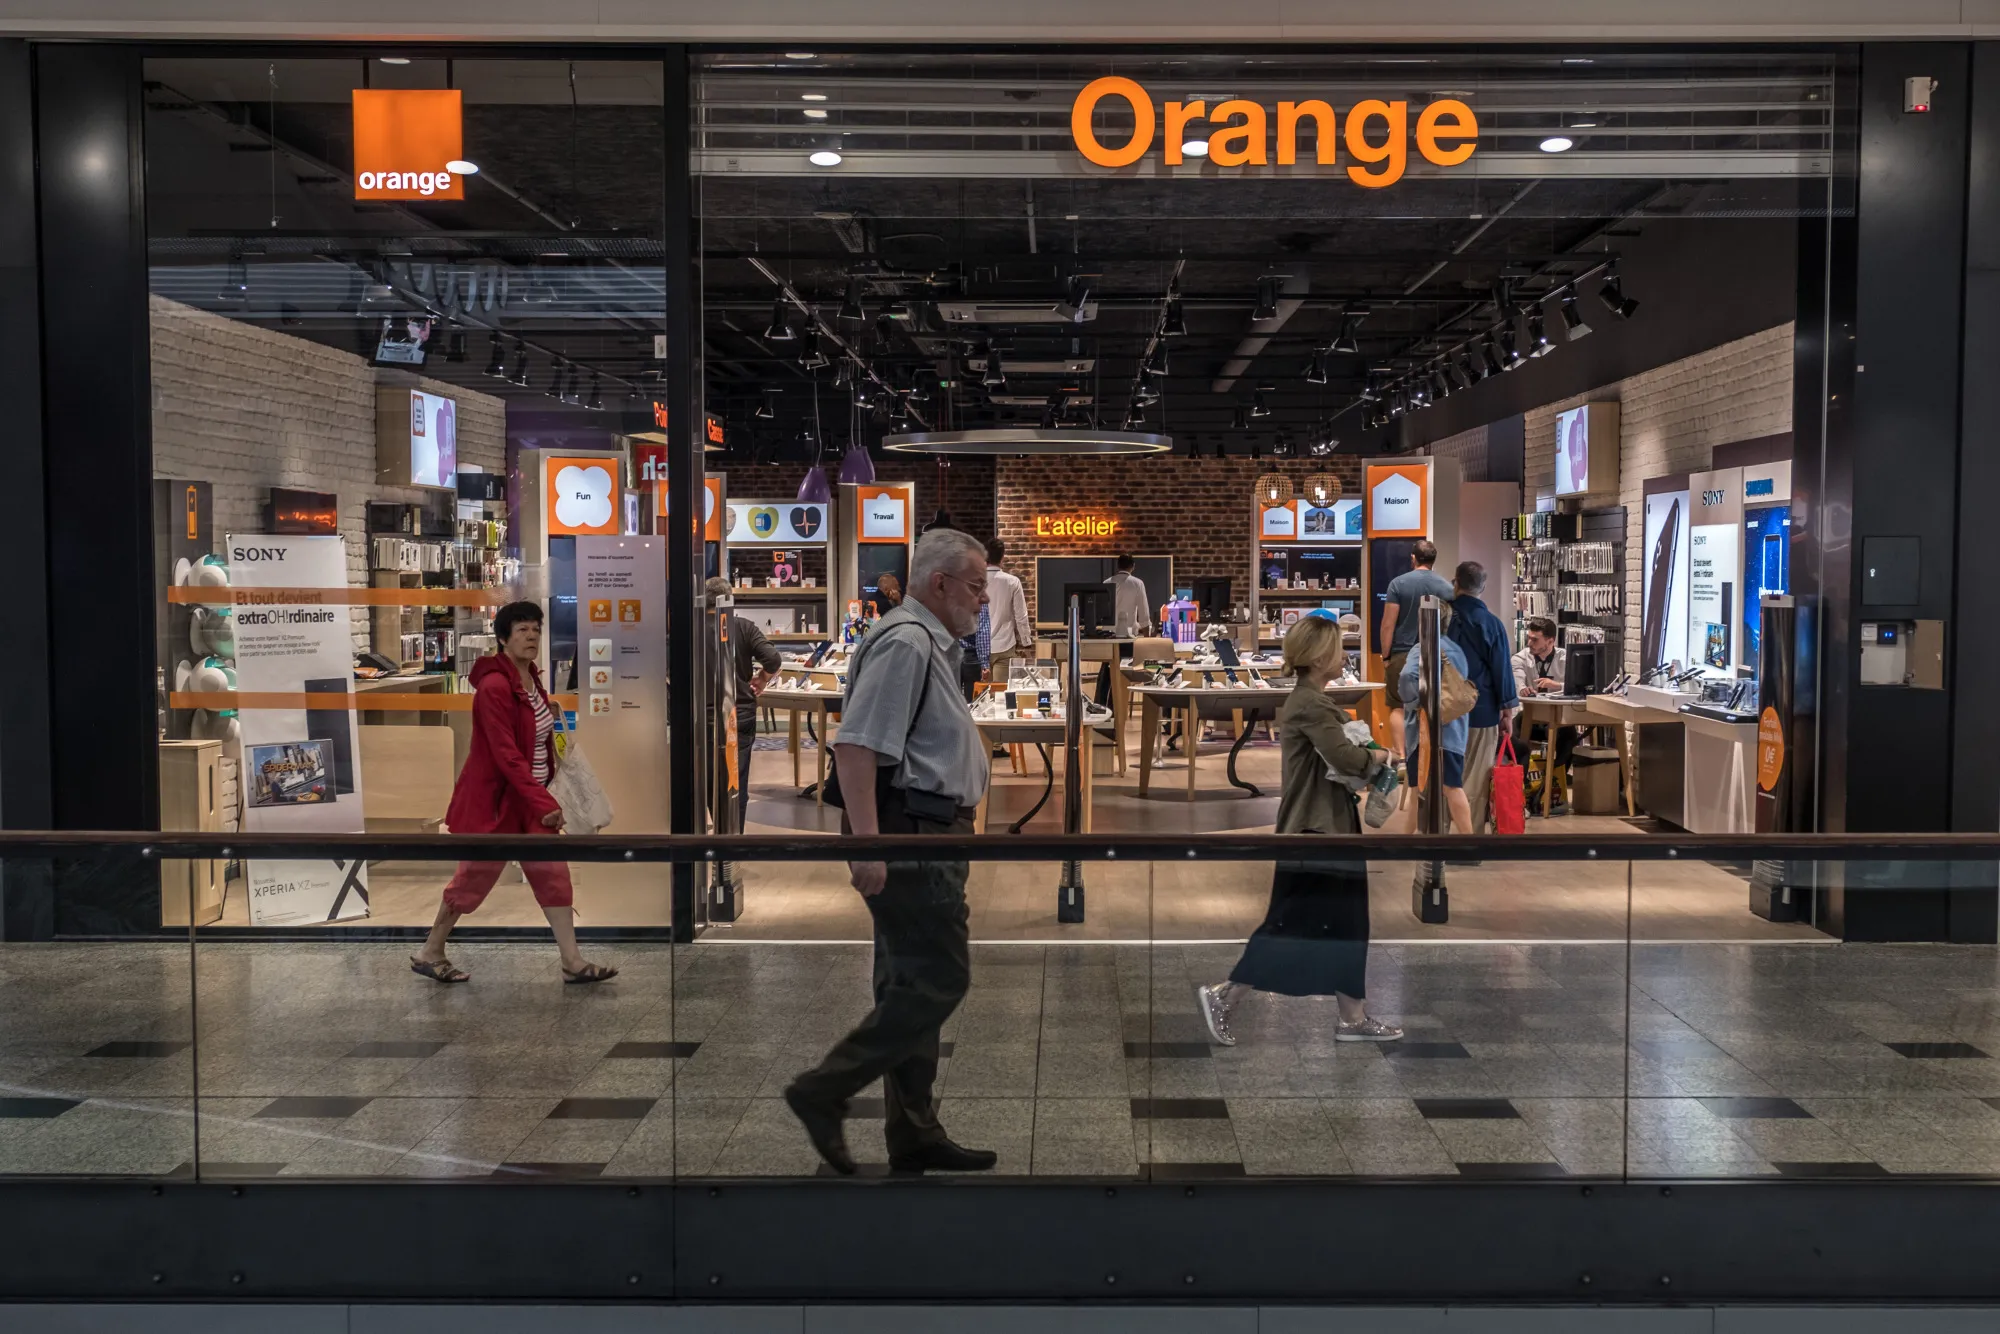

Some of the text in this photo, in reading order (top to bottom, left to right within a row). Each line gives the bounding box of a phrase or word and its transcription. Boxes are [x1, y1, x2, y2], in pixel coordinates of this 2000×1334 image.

[1072, 76, 1478, 187] Orange
[359, 169, 451, 195] orange
[576, 491, 591, 500] Fun
[1383, 496, 1410, 505] Maison
[1702, 490, 1724, 506] SONY
[873, 513, 894, 521] Travail
[1036, 516, 1117, 537] L'atelier
[233, 547, 288, 562] SONY
[236, 589, 322, 605] Et tout devient
[254, 882, 296, 898] XPERIA
[297, 880, 310, 890] XZ
